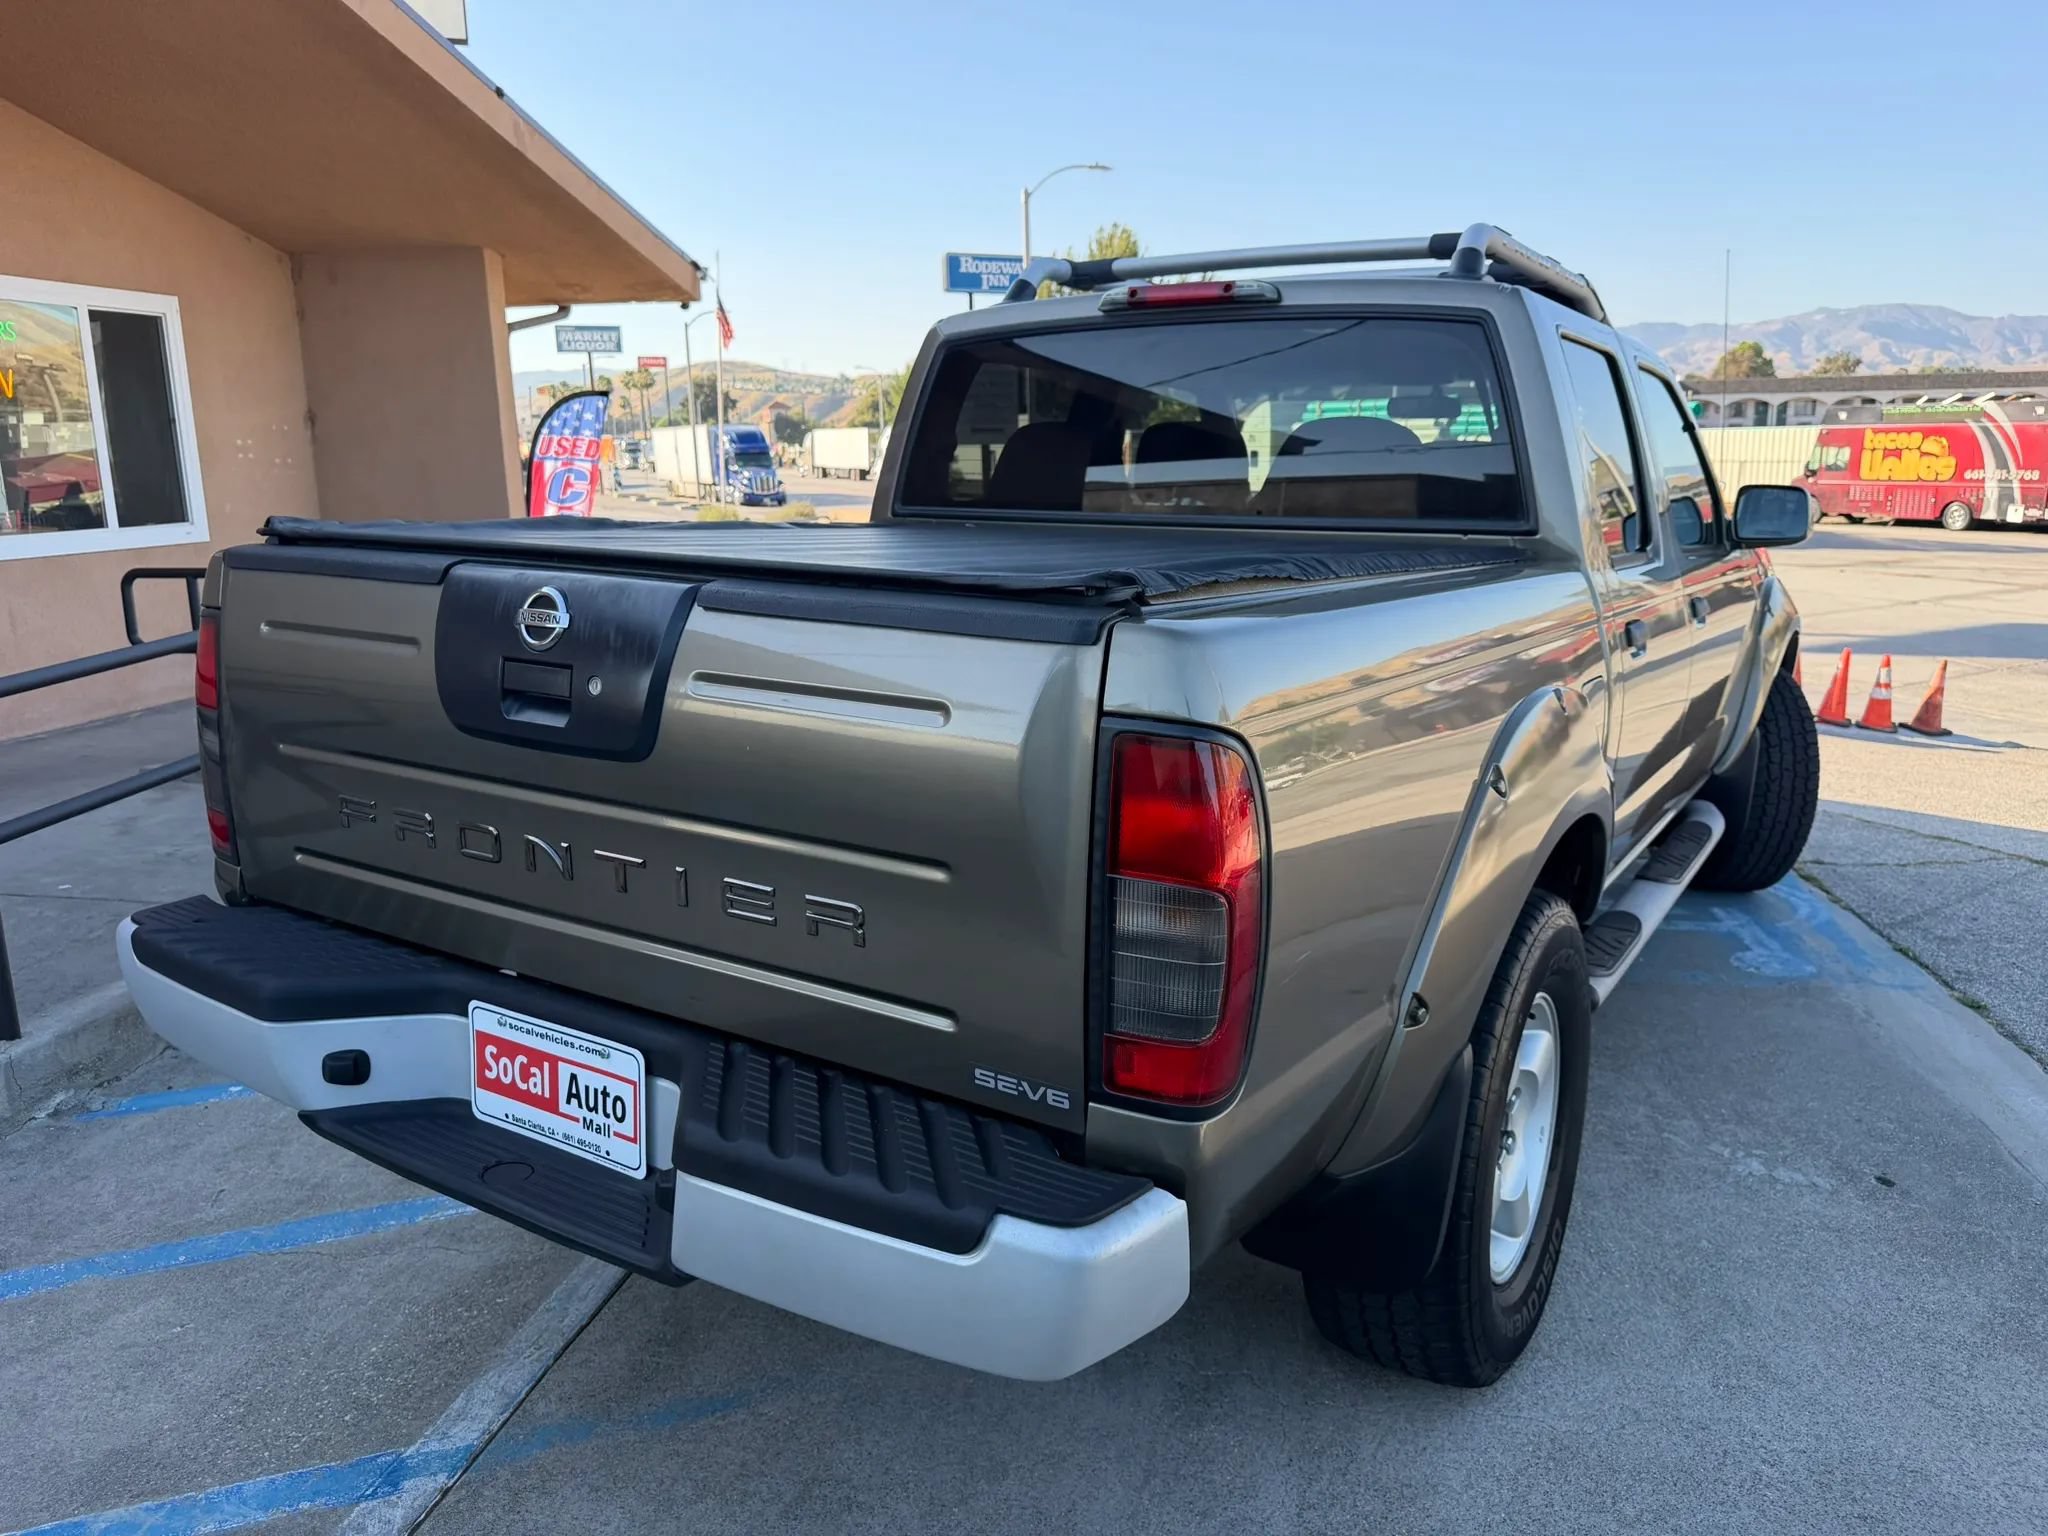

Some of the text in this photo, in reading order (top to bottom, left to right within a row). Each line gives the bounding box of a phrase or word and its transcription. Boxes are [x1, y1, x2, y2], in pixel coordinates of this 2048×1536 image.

[958, 256, 1025, 273] RODEWA
[981, 274, 1010, 290] INN
[561, 331, 618, 343] MARKET
[538, 435, 600, 460] USED
[519, 609, 562, 625] NISSAN
[338, 794, 866, 948] FRONTIER
[508, 1022, 600, 1057] socalvehicles.com
[484, 1044, 627, 1124] SoCal Auto
[511, 1114, 527, 1127] Santa
[547, 1126, 556, 1137] CA
[561, 1131, 576, 1145] (661)
[582, 1116, 611, 1139] Mall
